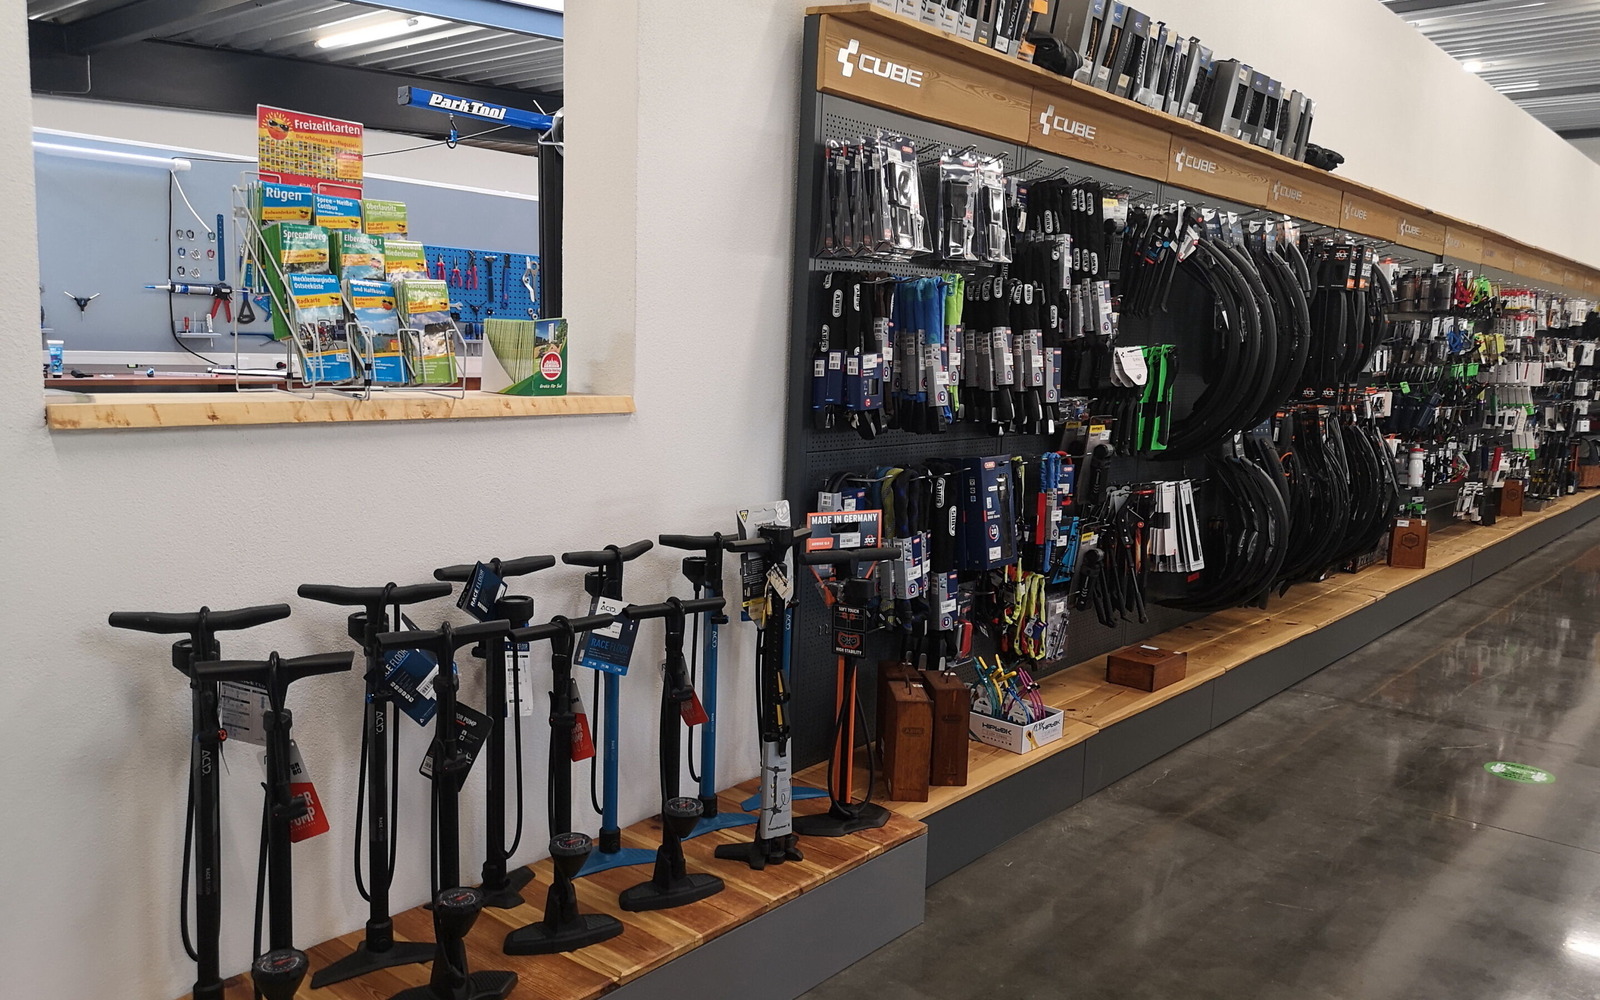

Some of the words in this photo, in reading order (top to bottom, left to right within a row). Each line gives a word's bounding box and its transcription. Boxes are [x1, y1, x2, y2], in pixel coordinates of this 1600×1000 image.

[858, 53, 924, 88] CUBE
[294, 119, 360, 135] Freizeitkarten
[1053, 116, 1097, 140] CUBE
[1185, 155, 1217, 174] CUBE
[266, 186, 302, 202] Rügen
[1280, 186, 1302, 200] CUBE
[317, 203, 339, 211] Cottbus
[366, 203, 397, 212] Oberlausitz
[1351, 207, 1367, 220] CUBE
[283, 229, 327, 243] Spreeradweg
[1405, 223, 1420, 236] CUBE
[292, 276, 337, 284] Mecklenburgische
[811, 515, 833, 524] MADE
[834, 515, 841, 523] IN
[843, 513, 878, 523] GERMANY
[470, 589, 478, 608] RACE
[591, 638, 610, 650] RACE
[376, 710, 384, 735] ACID.
[463, 716, 477, 727] PUMP
[201, 749, 211, 776] ACID.
[768, 824, 787, 832] Transformer
